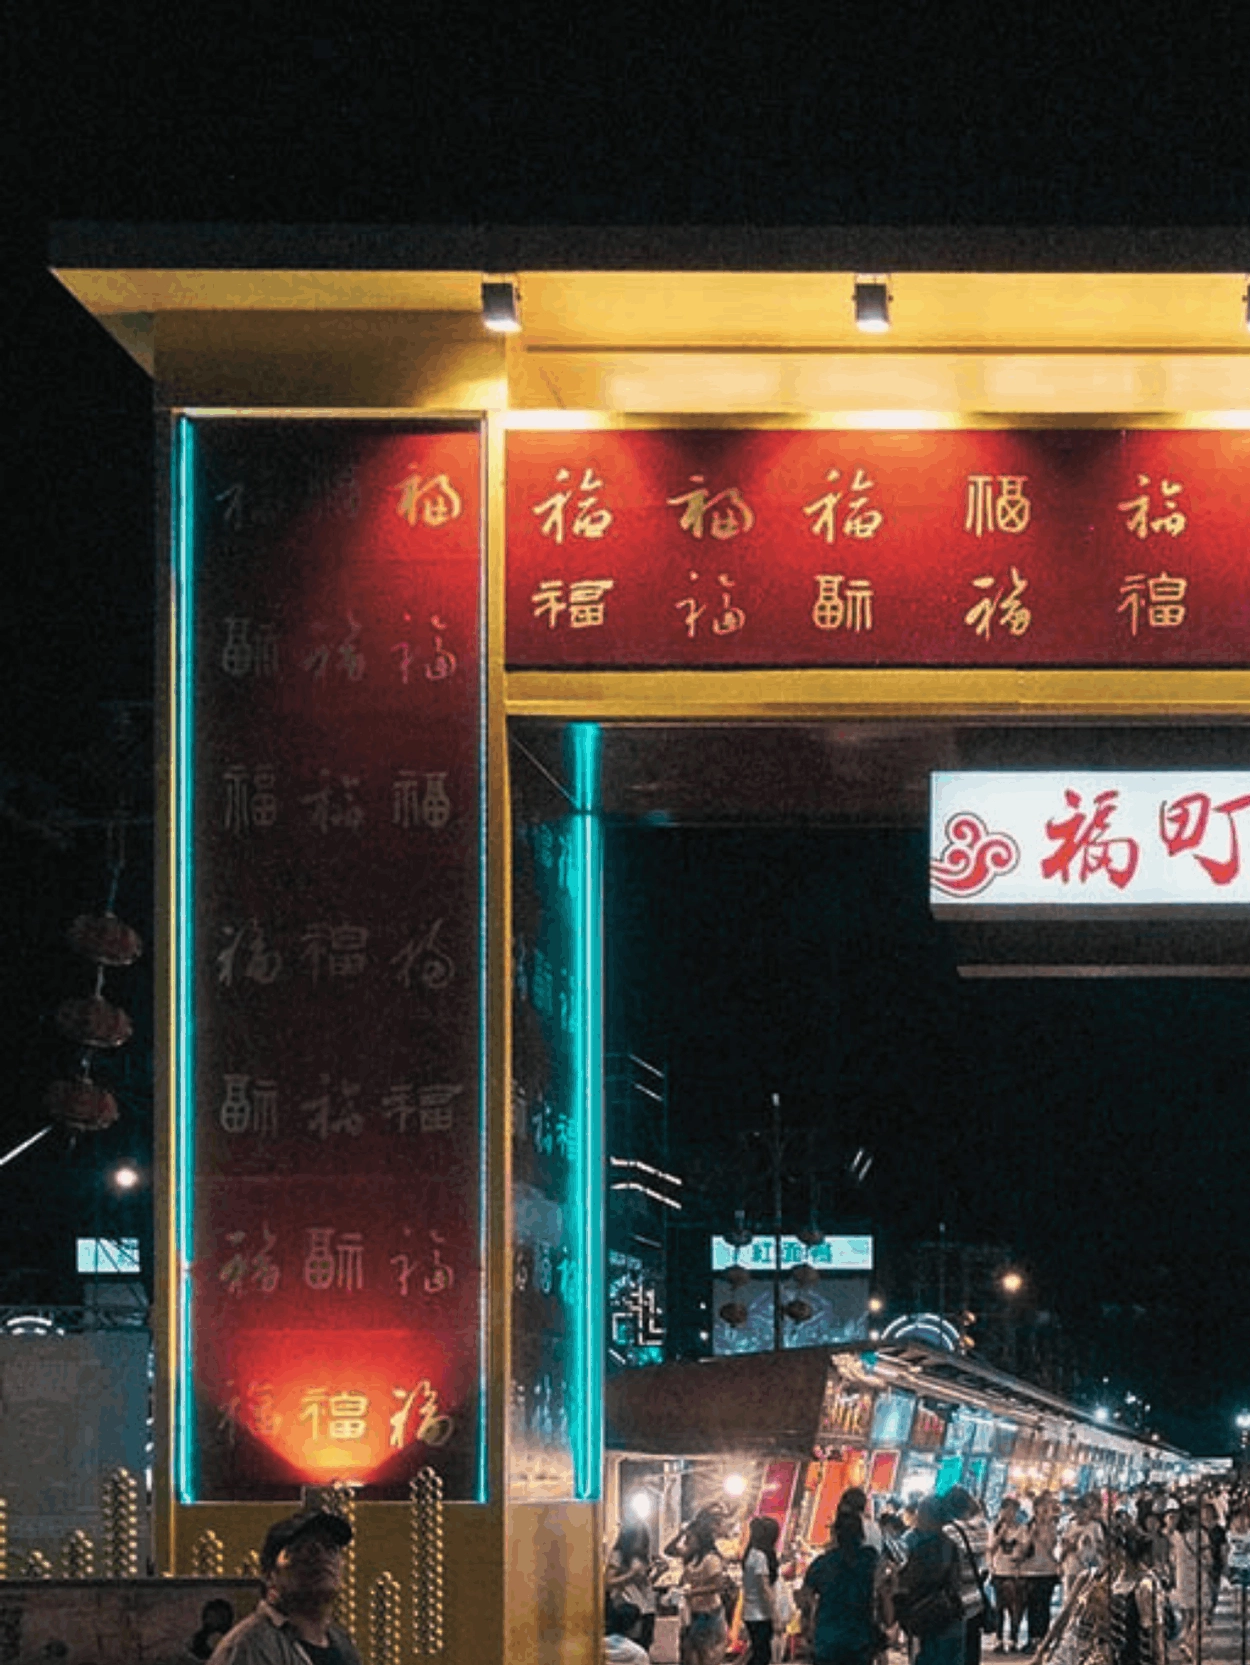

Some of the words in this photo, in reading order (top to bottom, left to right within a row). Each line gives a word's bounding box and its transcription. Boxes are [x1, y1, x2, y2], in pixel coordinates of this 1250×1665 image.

[394, 463, 461, 527] 福
[533, 469, 613, 543] 福
[668, 475, 754, 540] 福
[804, 469, 883, 543] 福
[966, 475, 1029, 536] 福
[1119, 475, 1188, 539] 福
[531, 579, 613, 629] 福
[676, 573, 745, 636] 福
[965, 568, 1030, 640] 福
[1118, 573, 1188, 633] 福
[391, 771, 451, 830] 福
[381, 1083, 464, 1134] 福
[300, 1390, 369, 1441] 福
[389, 1378, 455, 1448] 福
